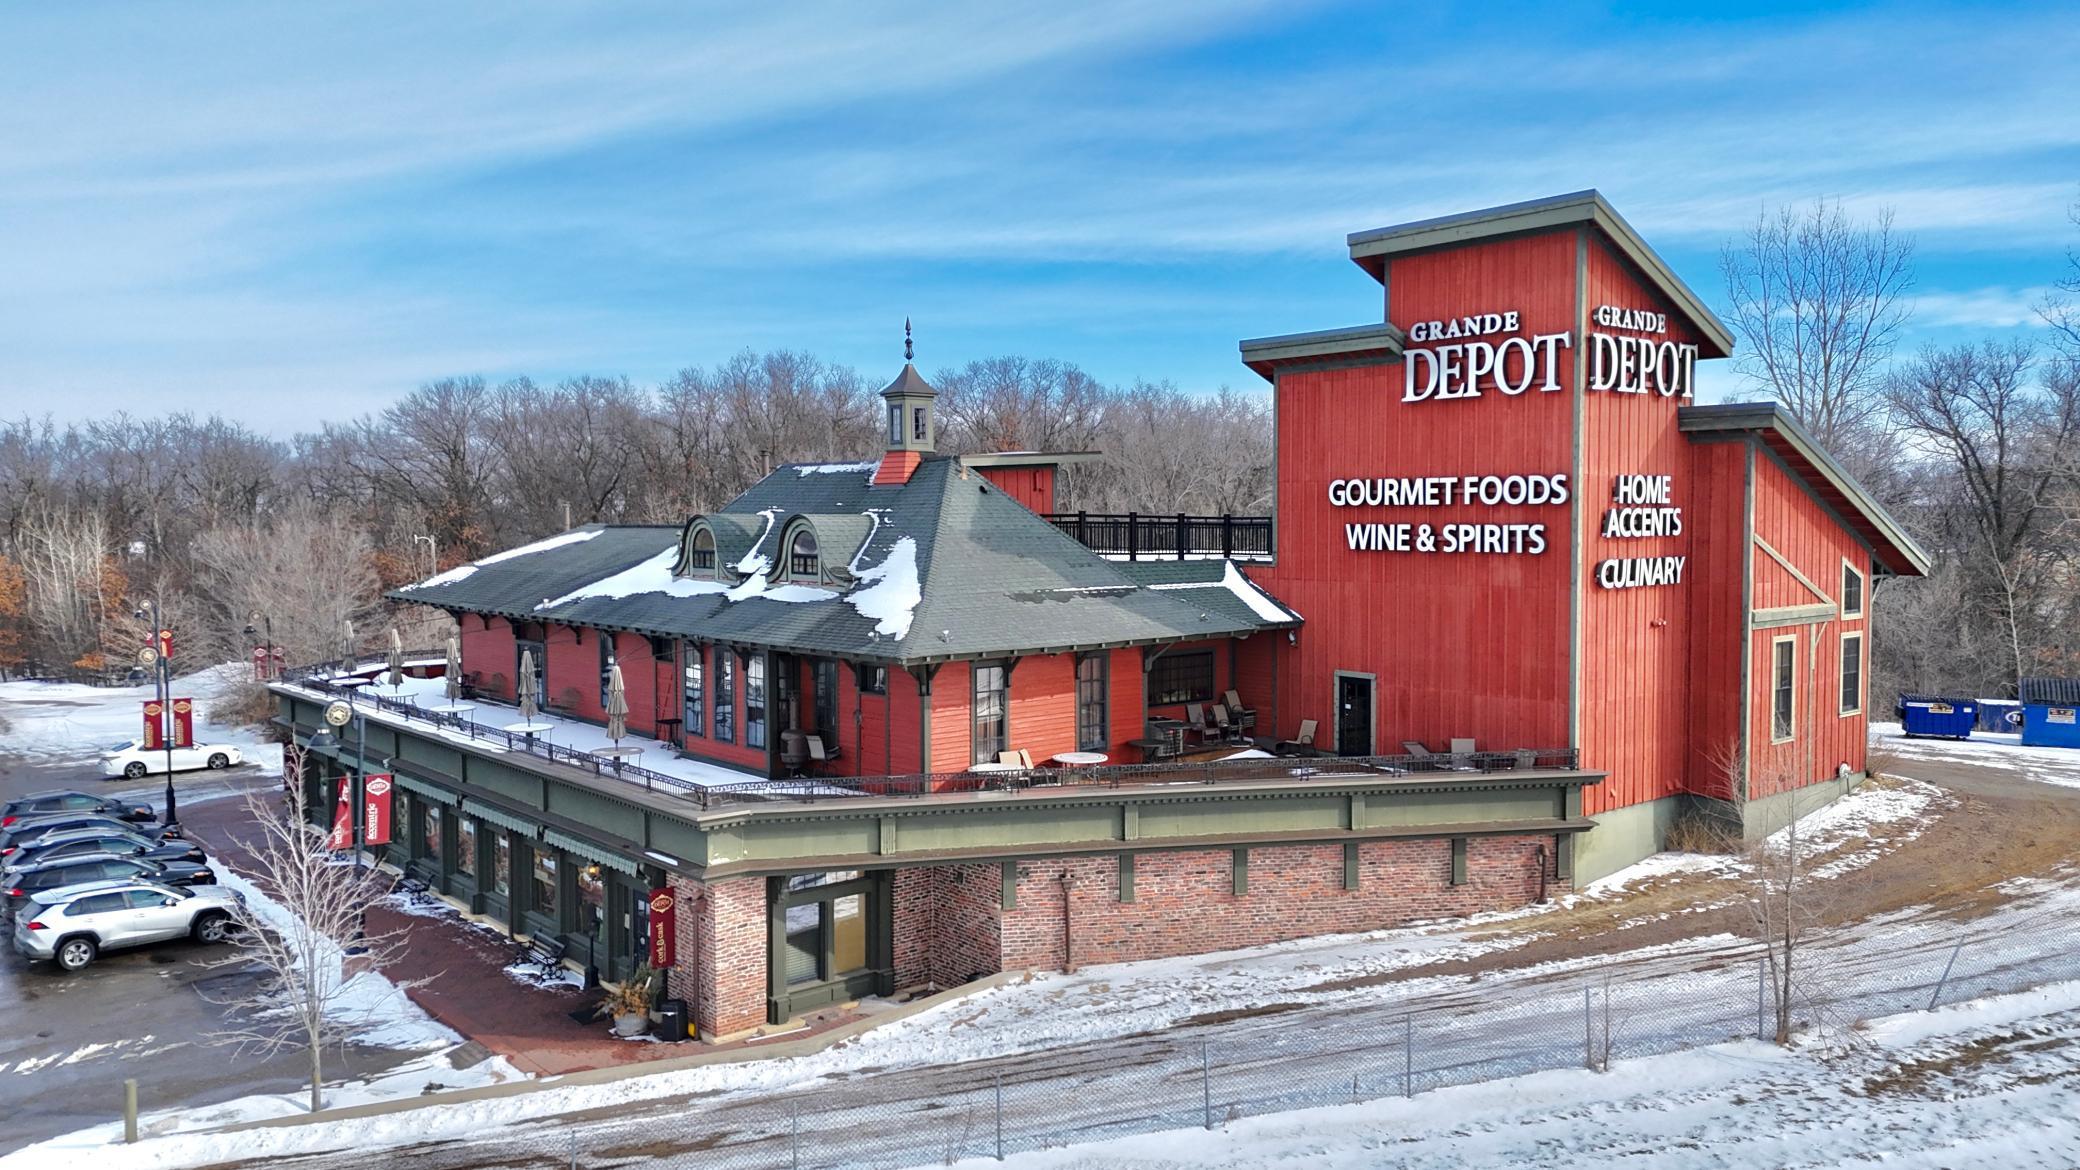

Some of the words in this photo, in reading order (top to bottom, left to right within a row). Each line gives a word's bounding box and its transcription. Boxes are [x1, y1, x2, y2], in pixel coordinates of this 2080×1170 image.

[1410, 311, 1519, 342] GRANDE
[1598, 305, 1666, 333] GRANDE
[1401, 331, 1572, 402] DEPOT
[1591, 332, 1698, 397] DEPOT
[1328, 477, 1458, 506] GOURMET
[1464, 474, 1568, 505] FOODS
[1618, 475, 1671, 504] HOME
[1606, 507, 1682, 538] ACCENTS
[1346, 524, 1410, 551] WINE
[1416, 523, 1436, 552] &
[1442, 524, 1545, 554] SPIRITS
[1600, 556, 1685, 589] CULINARY
